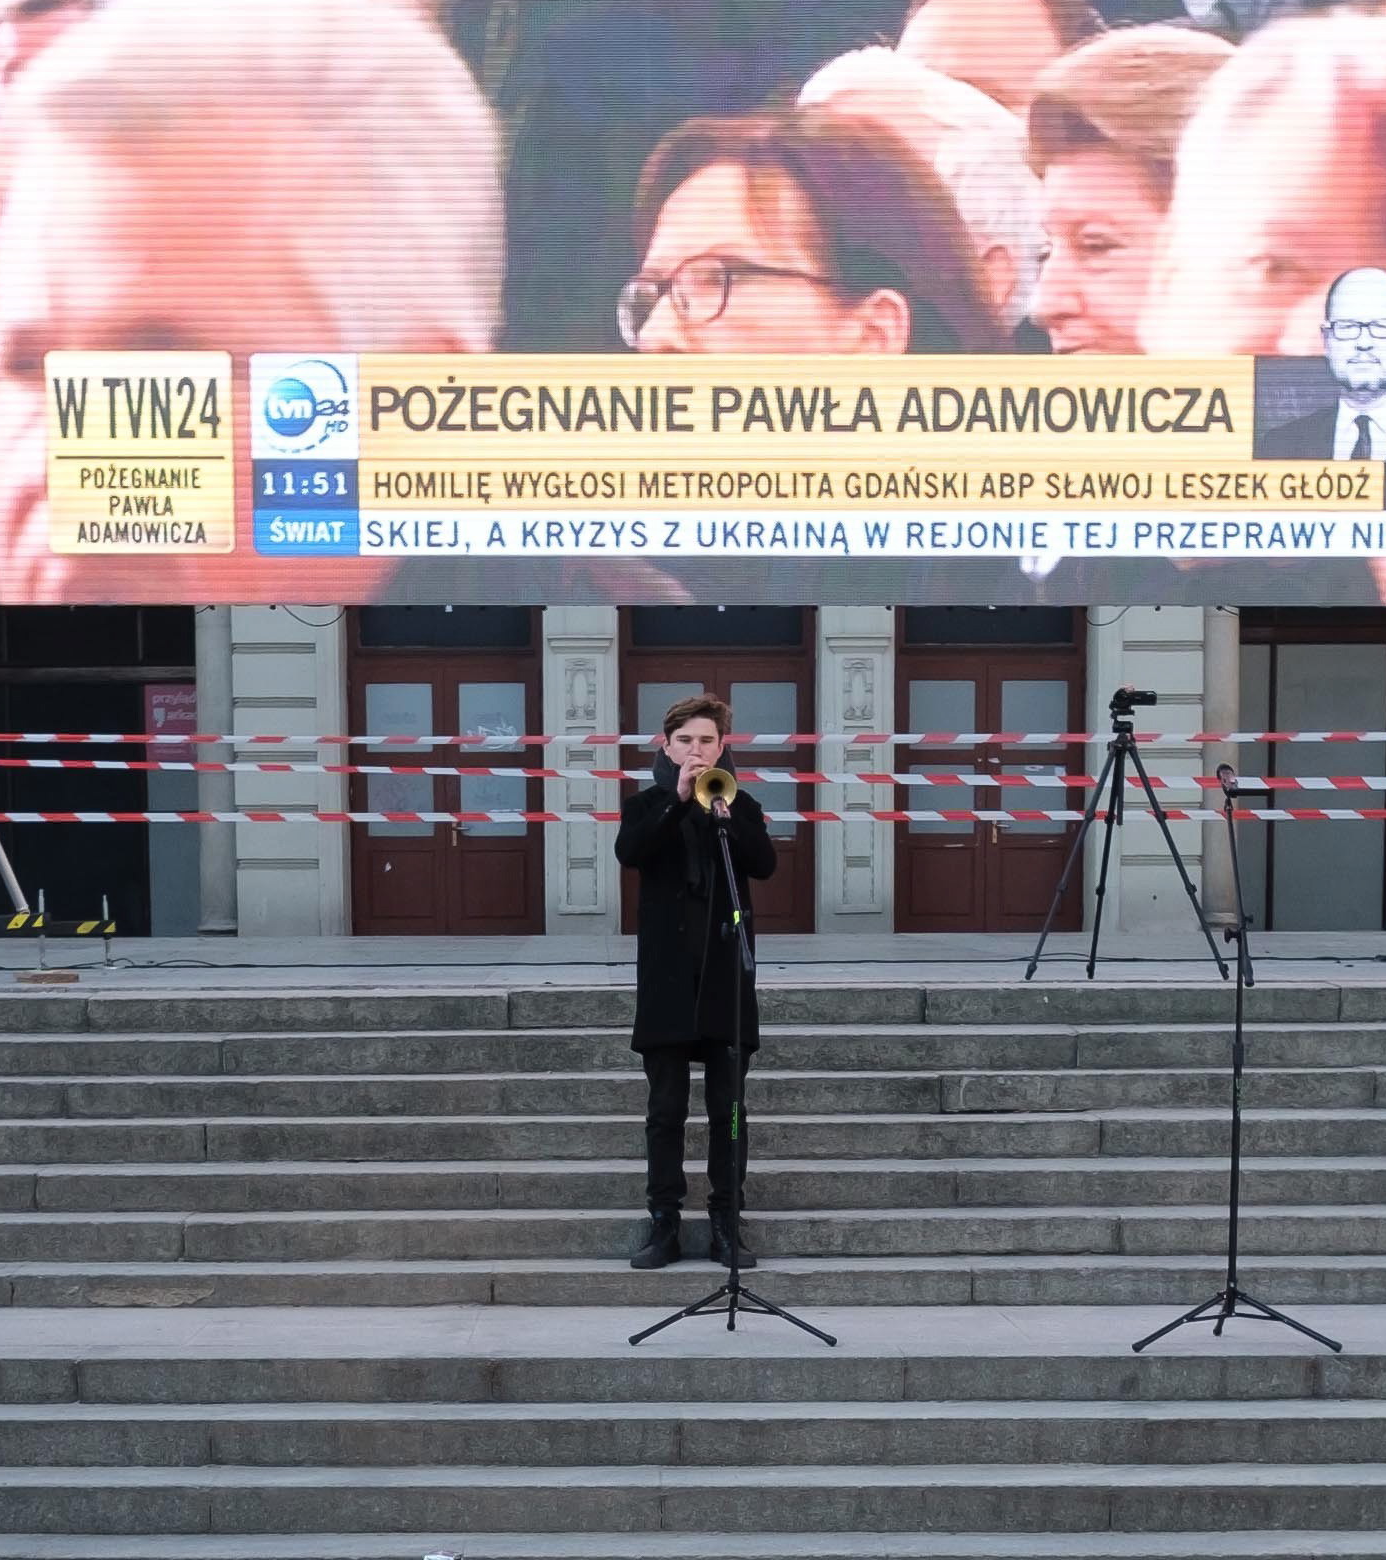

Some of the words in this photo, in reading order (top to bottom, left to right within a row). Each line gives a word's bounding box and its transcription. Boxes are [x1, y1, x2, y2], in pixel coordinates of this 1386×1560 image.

[54, 377, 88, 439] W
[102, 376, 221, 439] TVN24
[370, 375, 695, 433] POŻEGNANIE
[712, 385, 884, 433] PAWŁA
[896, 386, 1235, 434] ADAMOWICZA
[324, 419, 349, 434] HD
[79, 464, 202, 490] POŻEGNANIE
[261, 471, 349, 496] 11:51
[373, 471, 492, 504] HOMILIĘ
[503, 471, 626, 499] WYGŁOSI
[638, 471, 835, 499] METROPOLITA
[844, 464, 969, 500] GDAŃSKI
[979, 472, 1035, 500] ABP
[1044, 472, 1153, 500] SŁAWOJ
[1165, 472, 1268, 500] LESZEK
[1280, 464, 1370, 501] GŁÓDŹ
[108, 494, 174, 517] PAWŁA
[76, 521, 208, 545] ADAMOWICZA
[269, 516, 346, 545] ŚWIAT
[366, 520, 471, 554] SKIEJ,
[486, 520, 506, 548] A
[521, 520, 649, 548] KRYZYS
[662, 521, 682, 549] Z
[697, 520, 850, 555] UKRAINĄ
[862, 521, 891, 549] W
[905, 521, 1048, 549] REJONIE
[1066, 521, 1117, 550] TEJ
[1133, 522, 1339, 550] PRZEPRAWY
